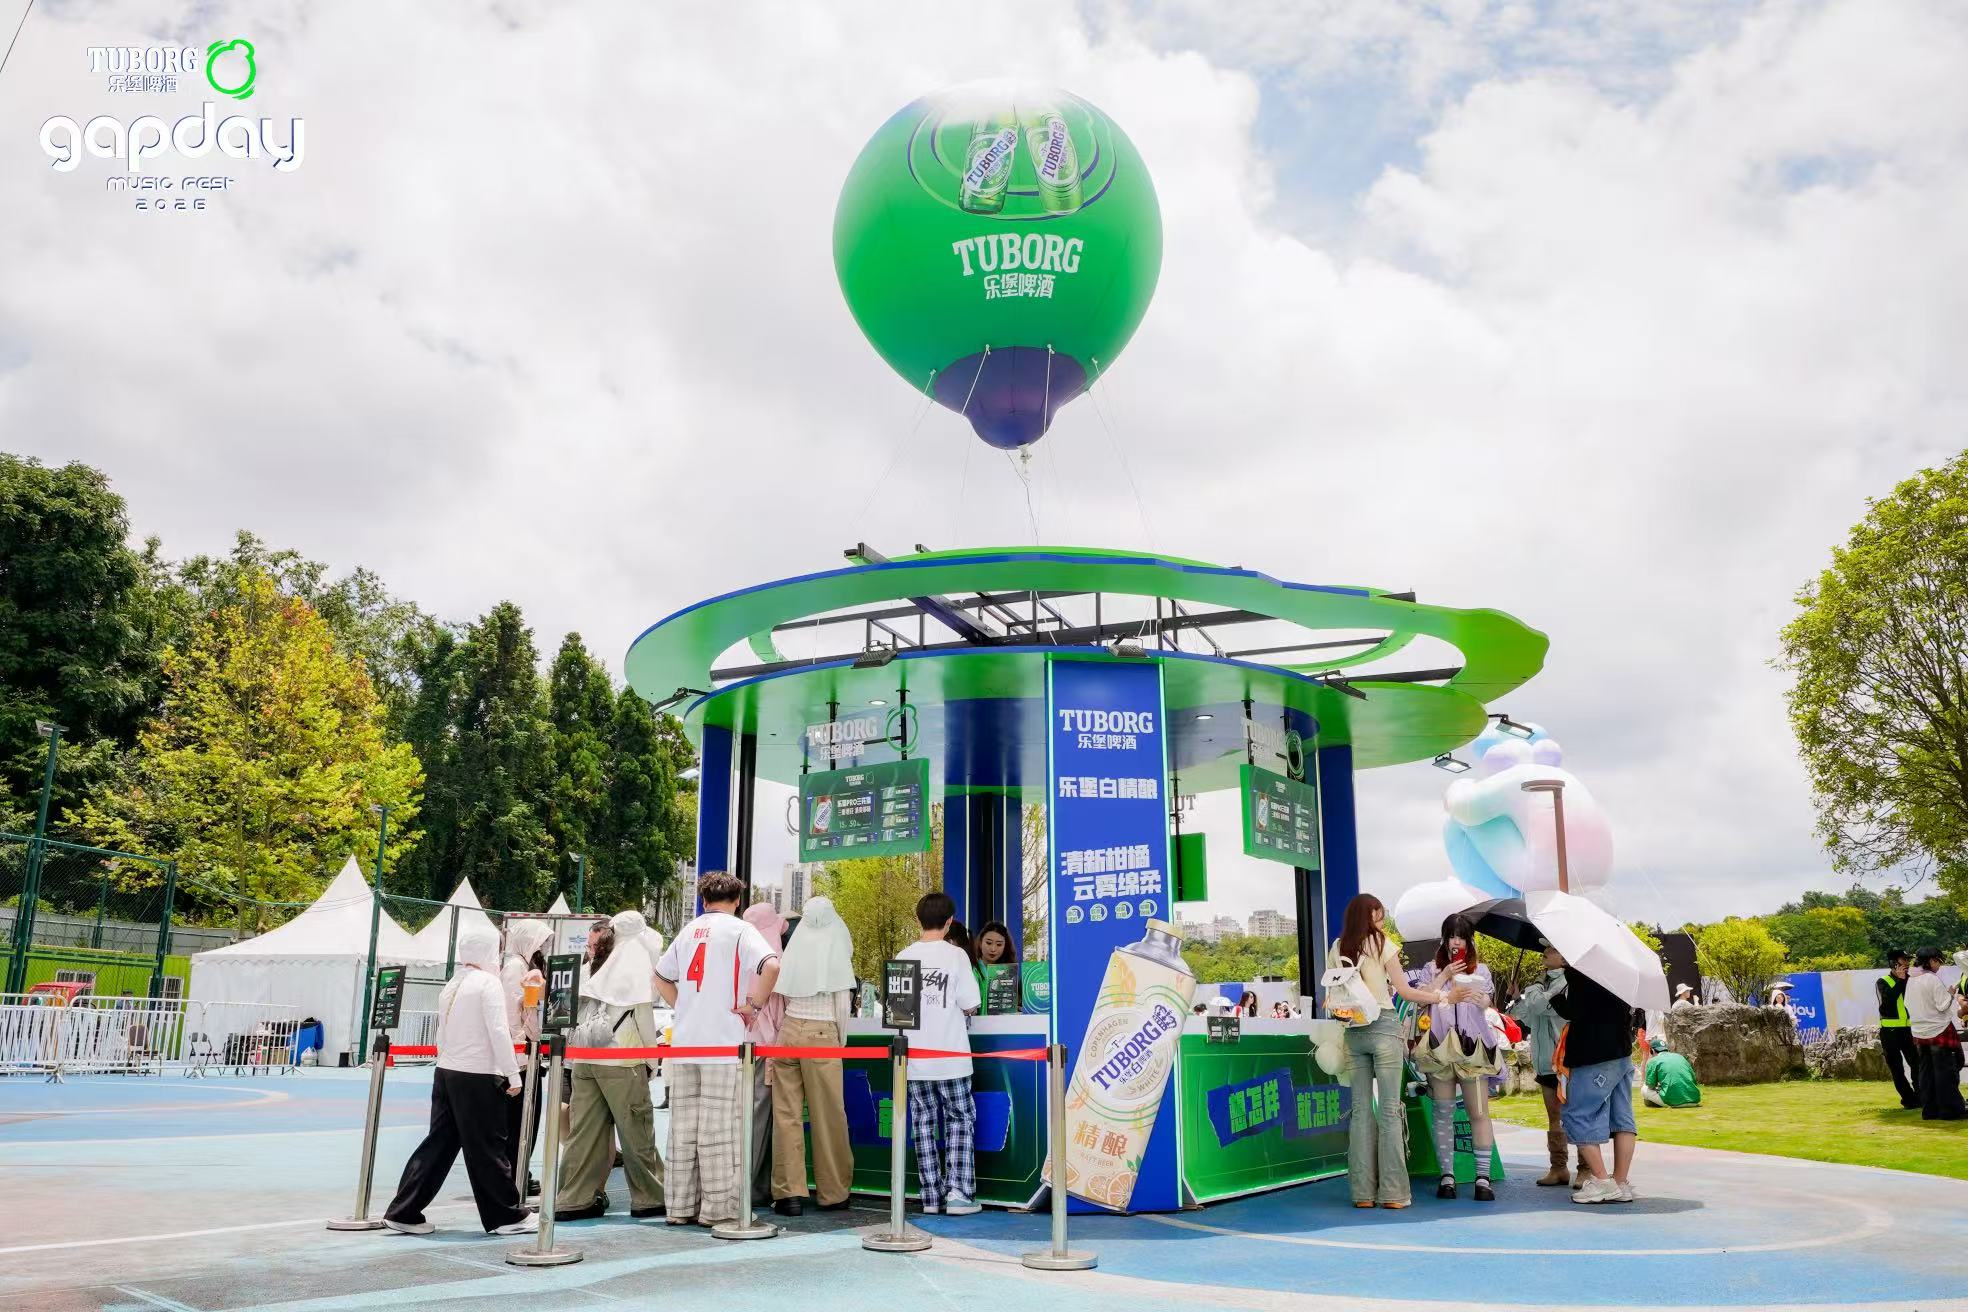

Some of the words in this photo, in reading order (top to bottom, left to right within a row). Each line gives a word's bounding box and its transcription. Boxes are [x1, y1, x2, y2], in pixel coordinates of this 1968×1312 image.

[967, 139, 1010, 186] TUBORG
[1042, 131, 1065, 178] TUBORG
[952, 232, 1084, 276] TUBORG
[984, 273, 1056, 300] 乐堡啤酒
[806, 717, 879, 746] TUBORG
[1059, 709, 1154, 733] TUBORG
[1077, 733, 1137, 750] 乐堡啤酒
[1059, 776, 1158, 800] 乐堡白精酿
[687, 942, 707, 993] 4
[888, 975, 913, 994] 出口
[1090, 1019, 1162, 1090] TUBORG
[1072, 1120, 1129, 1160] 精酿
